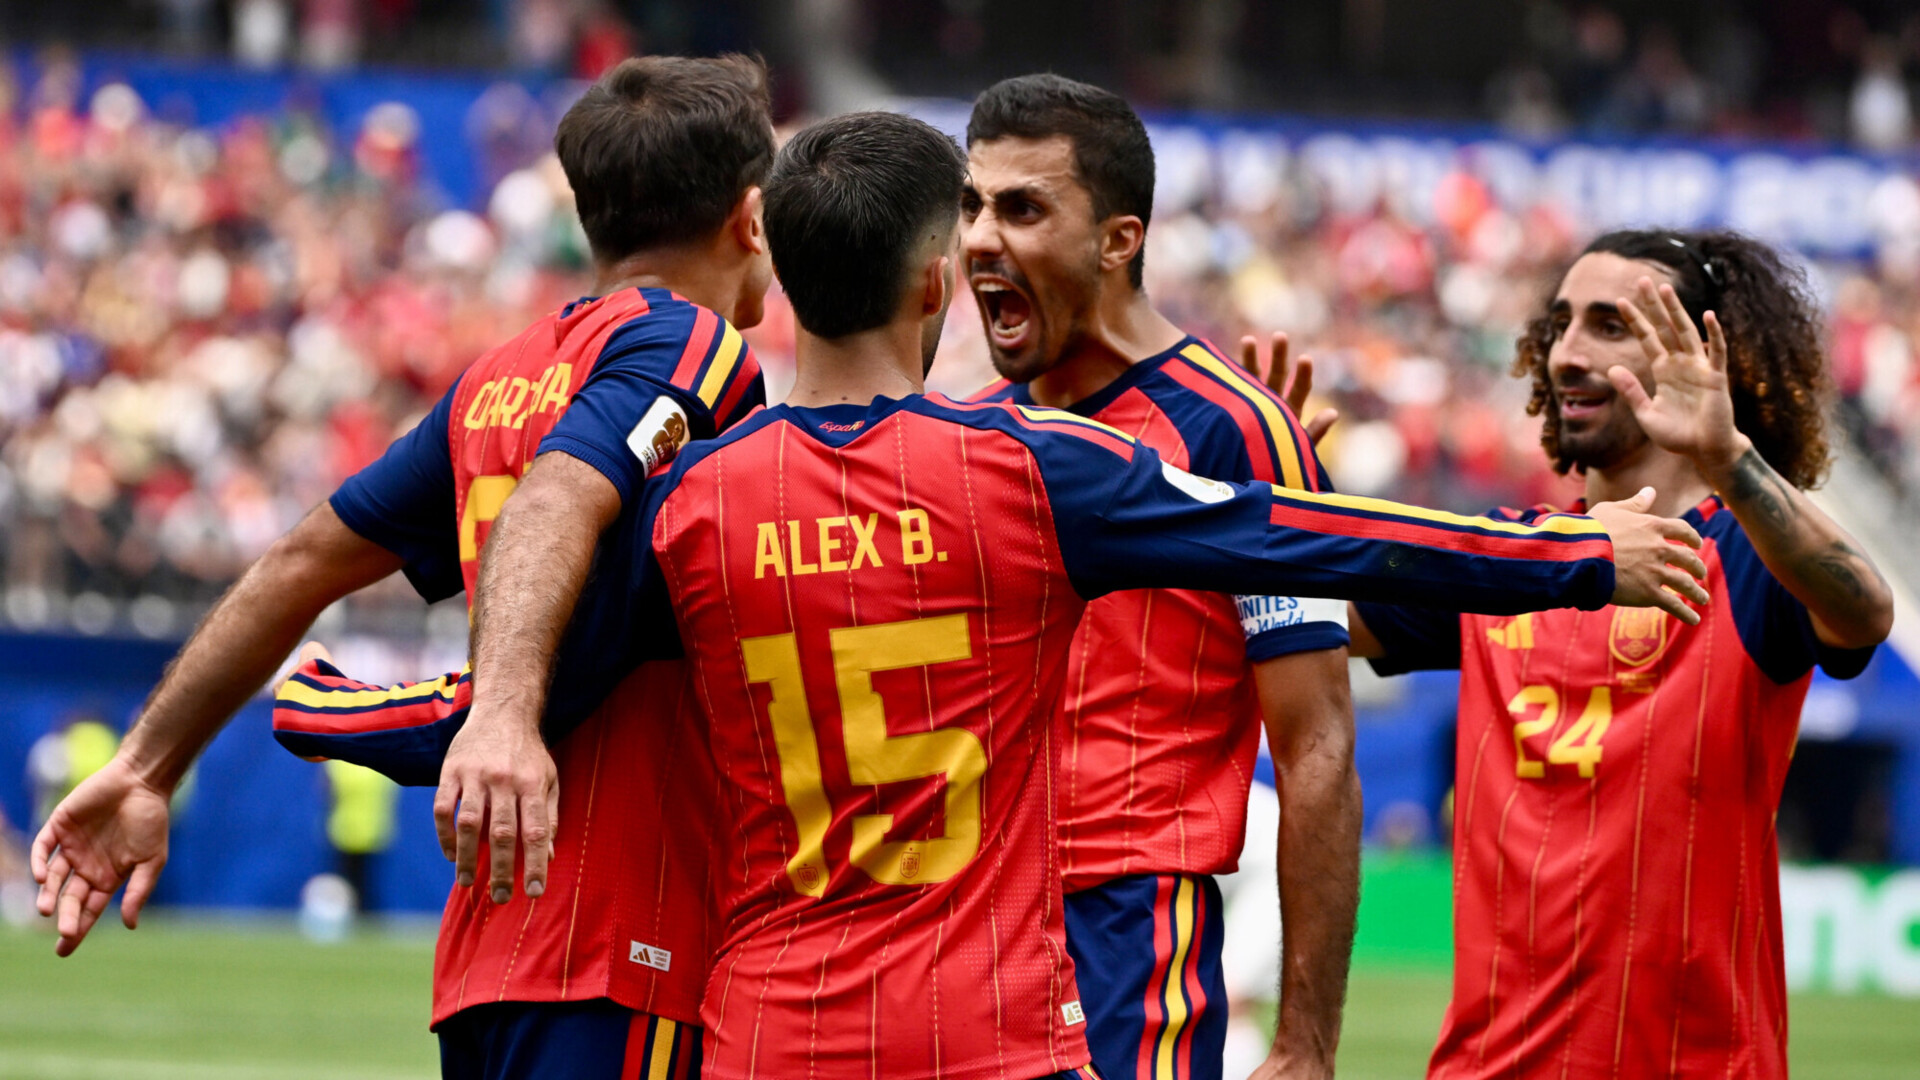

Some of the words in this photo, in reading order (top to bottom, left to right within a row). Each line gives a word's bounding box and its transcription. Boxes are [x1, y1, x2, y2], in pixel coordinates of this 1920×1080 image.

[754, 512, 884, 579] ALEX
[896, 508, 948, 565] B.
[740, 612, 987, 899] 15
[1507, 685, 1612, 778] 24
